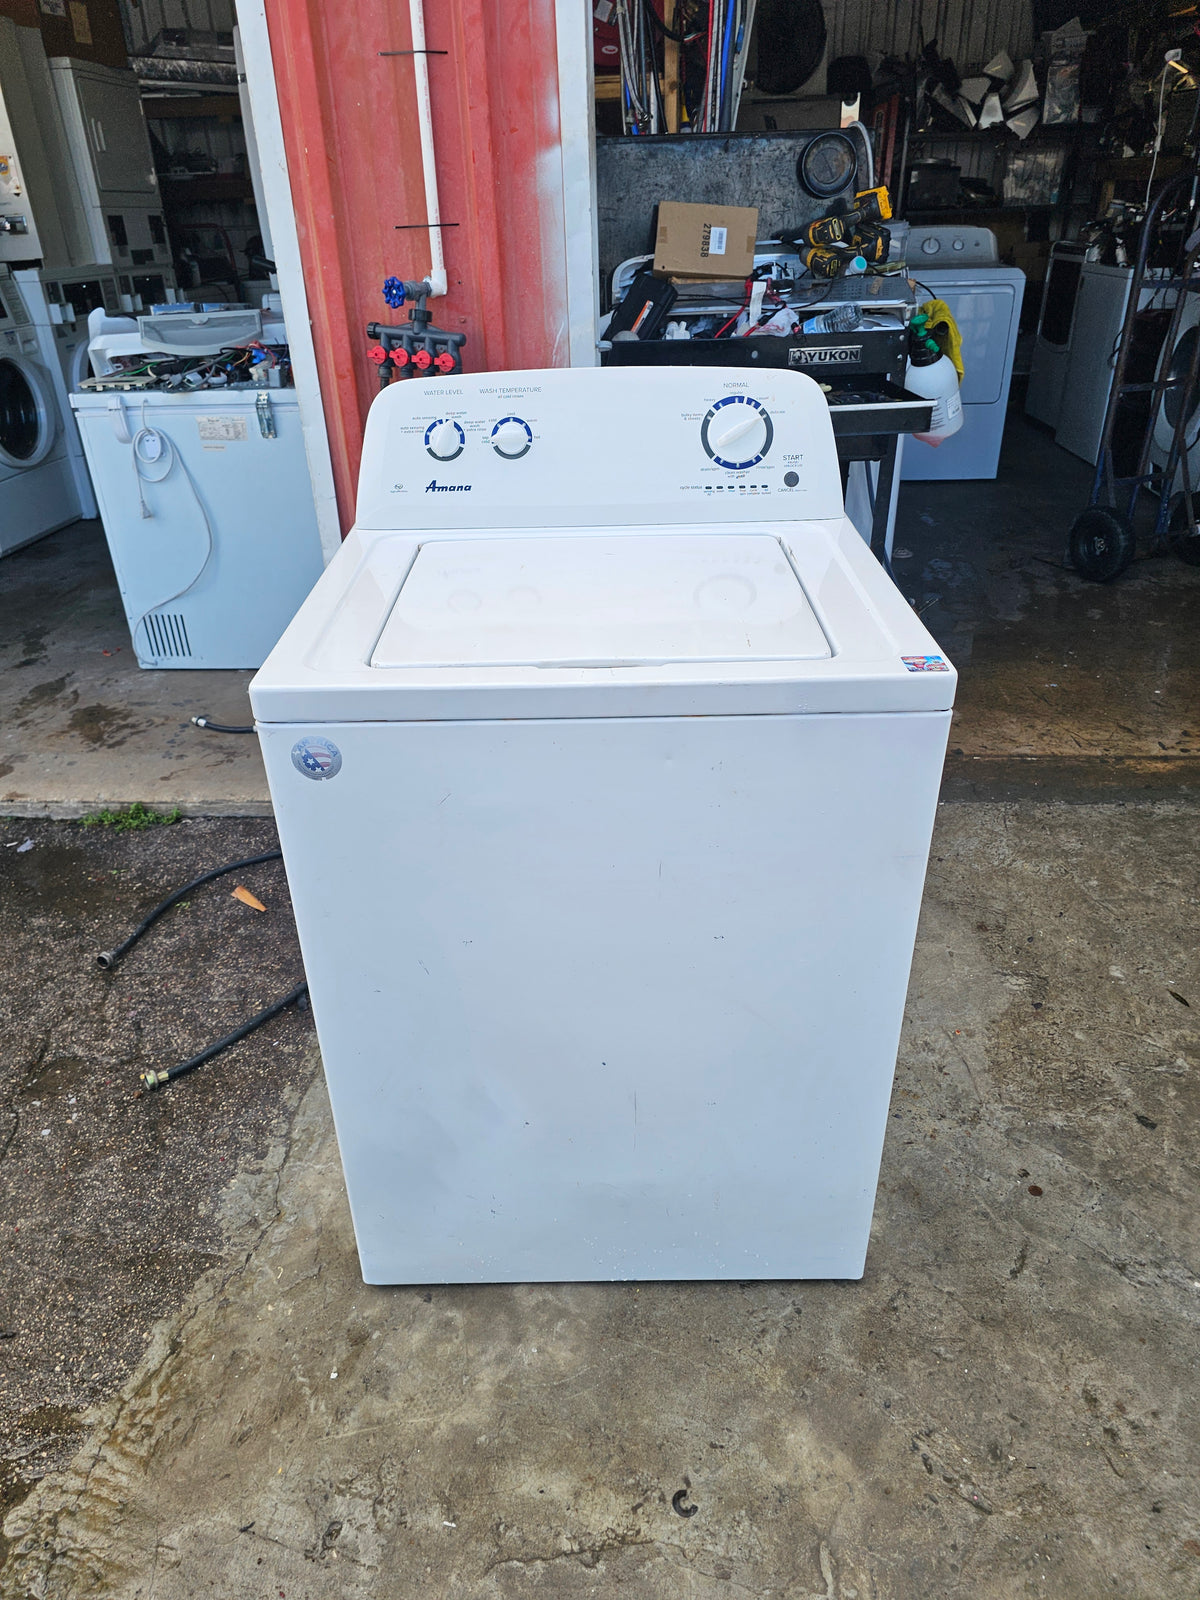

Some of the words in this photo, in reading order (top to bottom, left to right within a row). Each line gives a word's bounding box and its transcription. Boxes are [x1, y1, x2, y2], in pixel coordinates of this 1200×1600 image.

[700, 223, 712, 257] 279838
[808, 350, 859, 362] YUKON
[425, 480, 472, 493] Amana
[296, 737, 338, 757] AMERICA
